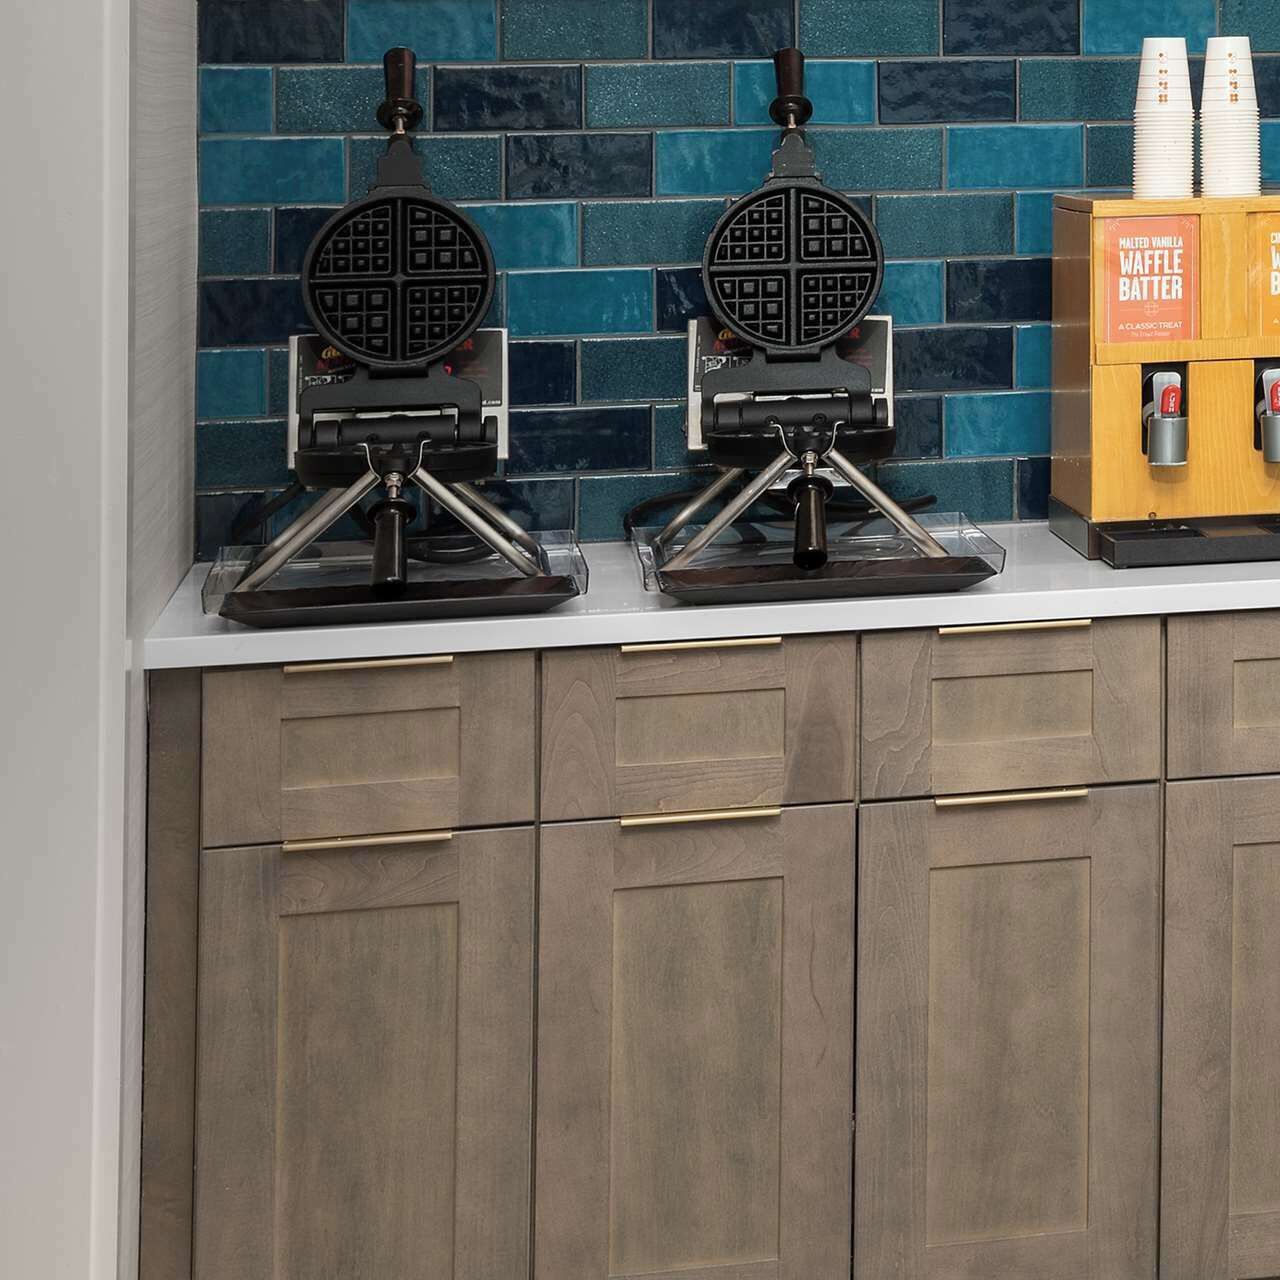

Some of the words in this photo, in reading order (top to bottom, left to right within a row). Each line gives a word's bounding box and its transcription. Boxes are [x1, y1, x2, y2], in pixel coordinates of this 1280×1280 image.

[1119, 237, 1149, 249] MALTED
[1151, 236, 1183, 248] VANILLA
[1119, 249, 1183, 275] WAFFLE
[1119, 275, 1183, 301] BATTER
[1125, 322, 1157, 330] CLASSIC
[1159, 321, 1183, 329] TREAT
